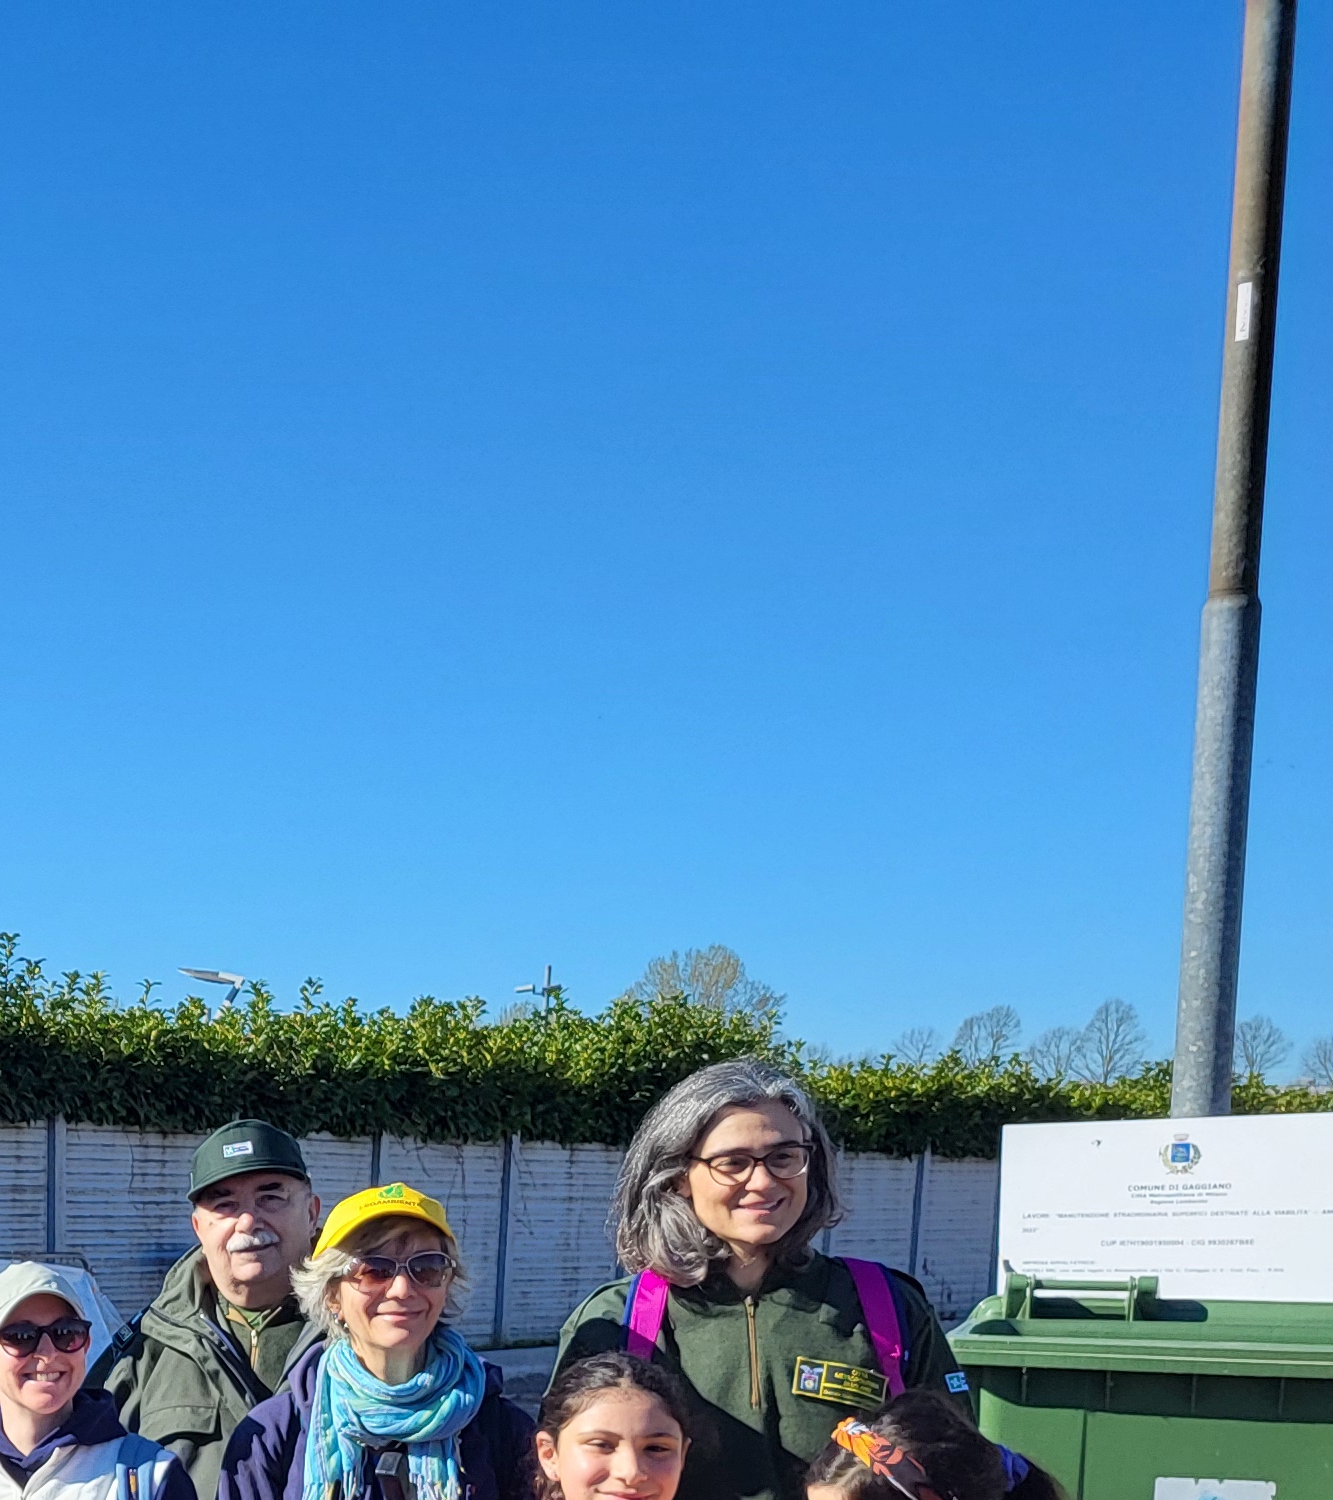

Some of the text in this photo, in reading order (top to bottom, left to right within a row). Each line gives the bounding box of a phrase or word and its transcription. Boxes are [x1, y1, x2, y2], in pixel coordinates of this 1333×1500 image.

[1128, 1182, 1232, 1192] COMUNE DI GAGGIANO
